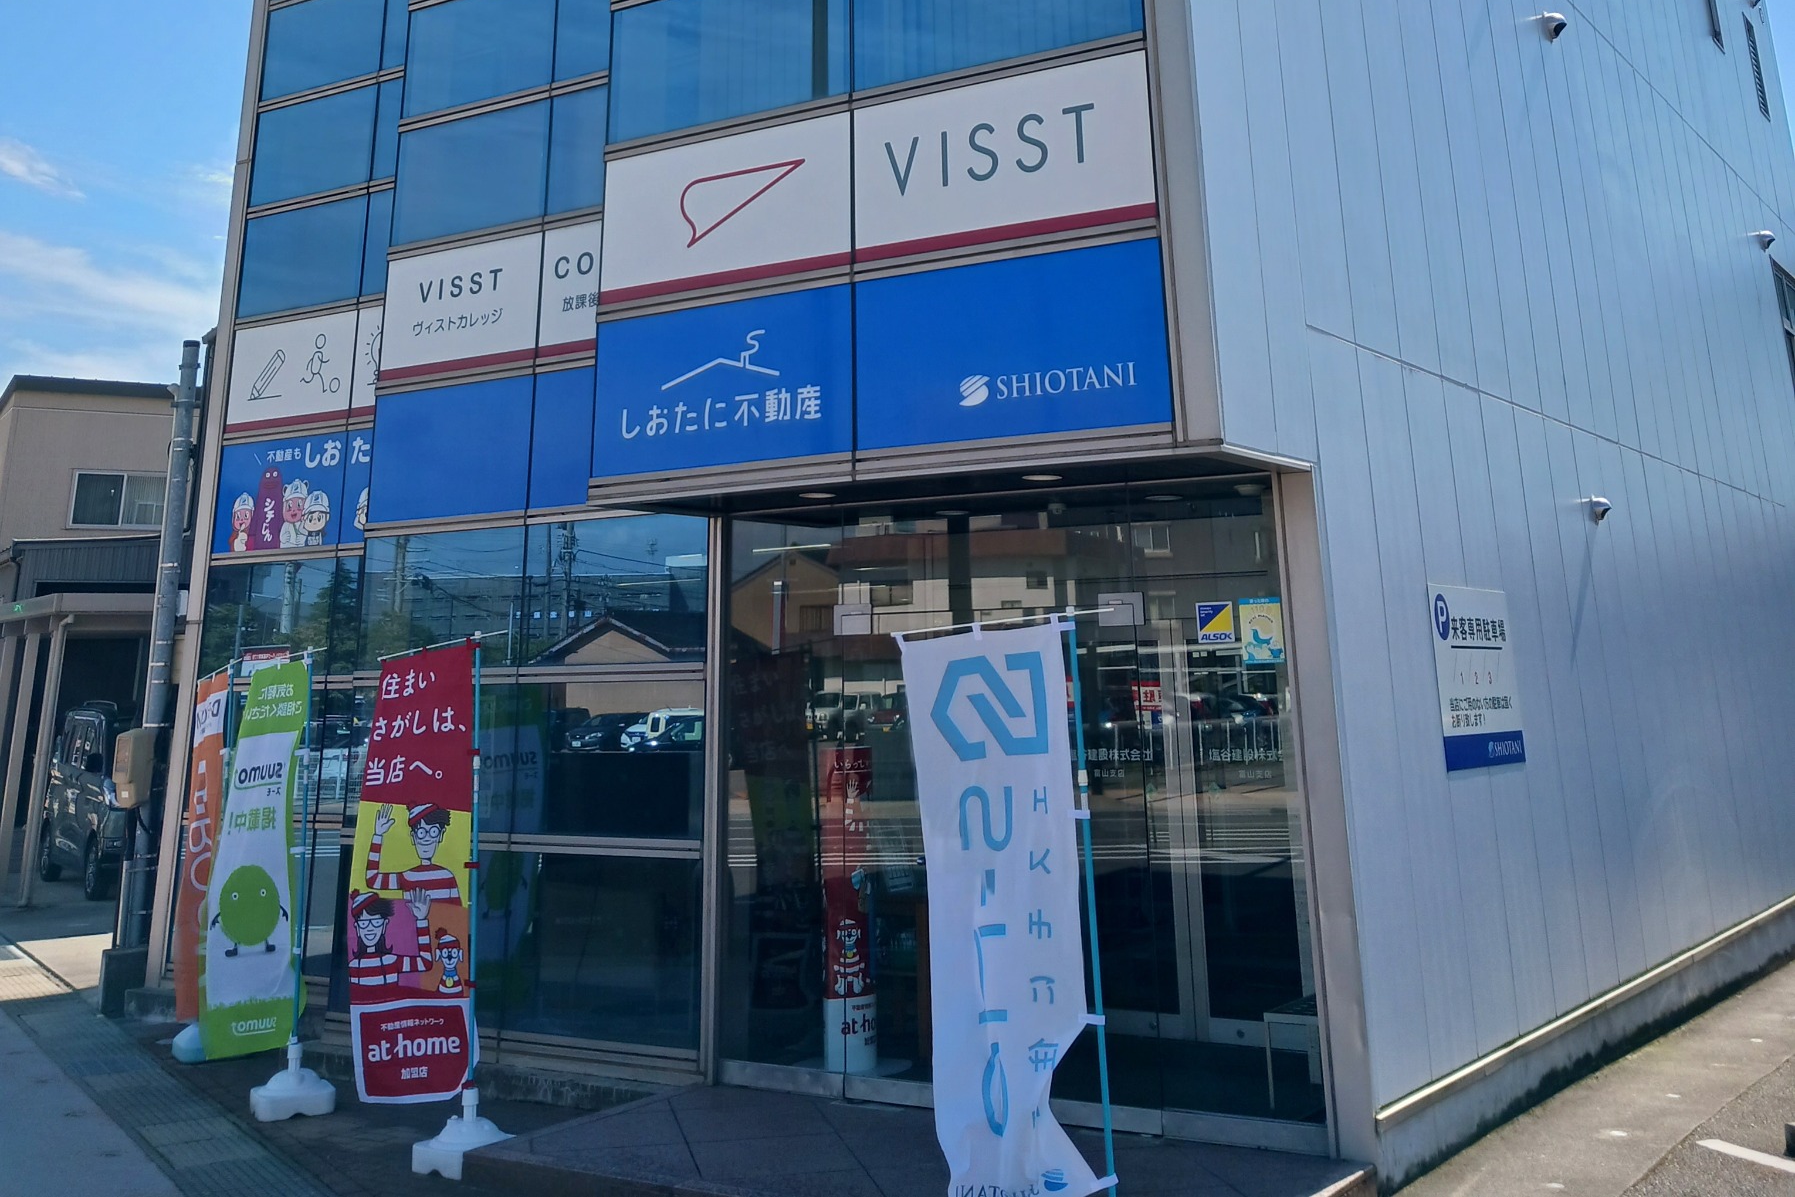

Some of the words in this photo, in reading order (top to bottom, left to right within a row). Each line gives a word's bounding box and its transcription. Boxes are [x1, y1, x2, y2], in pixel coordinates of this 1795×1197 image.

[884, 103, 1095, 196] VISST
[419, 268, 503, 303] VISST
[412, 308, 504, 337] ヴィストカレッジ
[996, 361, 1137, 401] SHIOTANI
[620, 384, 822, 439] しおたに不動産
[1437, 600, 1447, 633] P
[1450, 615, 1507, 643] 来客専用駐車場
[1201, 632, 1232, 641] ALSOK
[381, 669, 436, 700] 住まい
[1459, 671, 1465, 685] 1
[1473, 671, 1479, 685] 2
[373, 706, 466, 741] さがしは、
[365, 755, 443, 786] 当店へ。
[380, 1017, 445, 1032] 不動産情報ネットワーク
[368, 1040, 391, 1062] at
[394, 1033, 461, 1059] home
[401, 1066, 428, 1080] 加盟店
